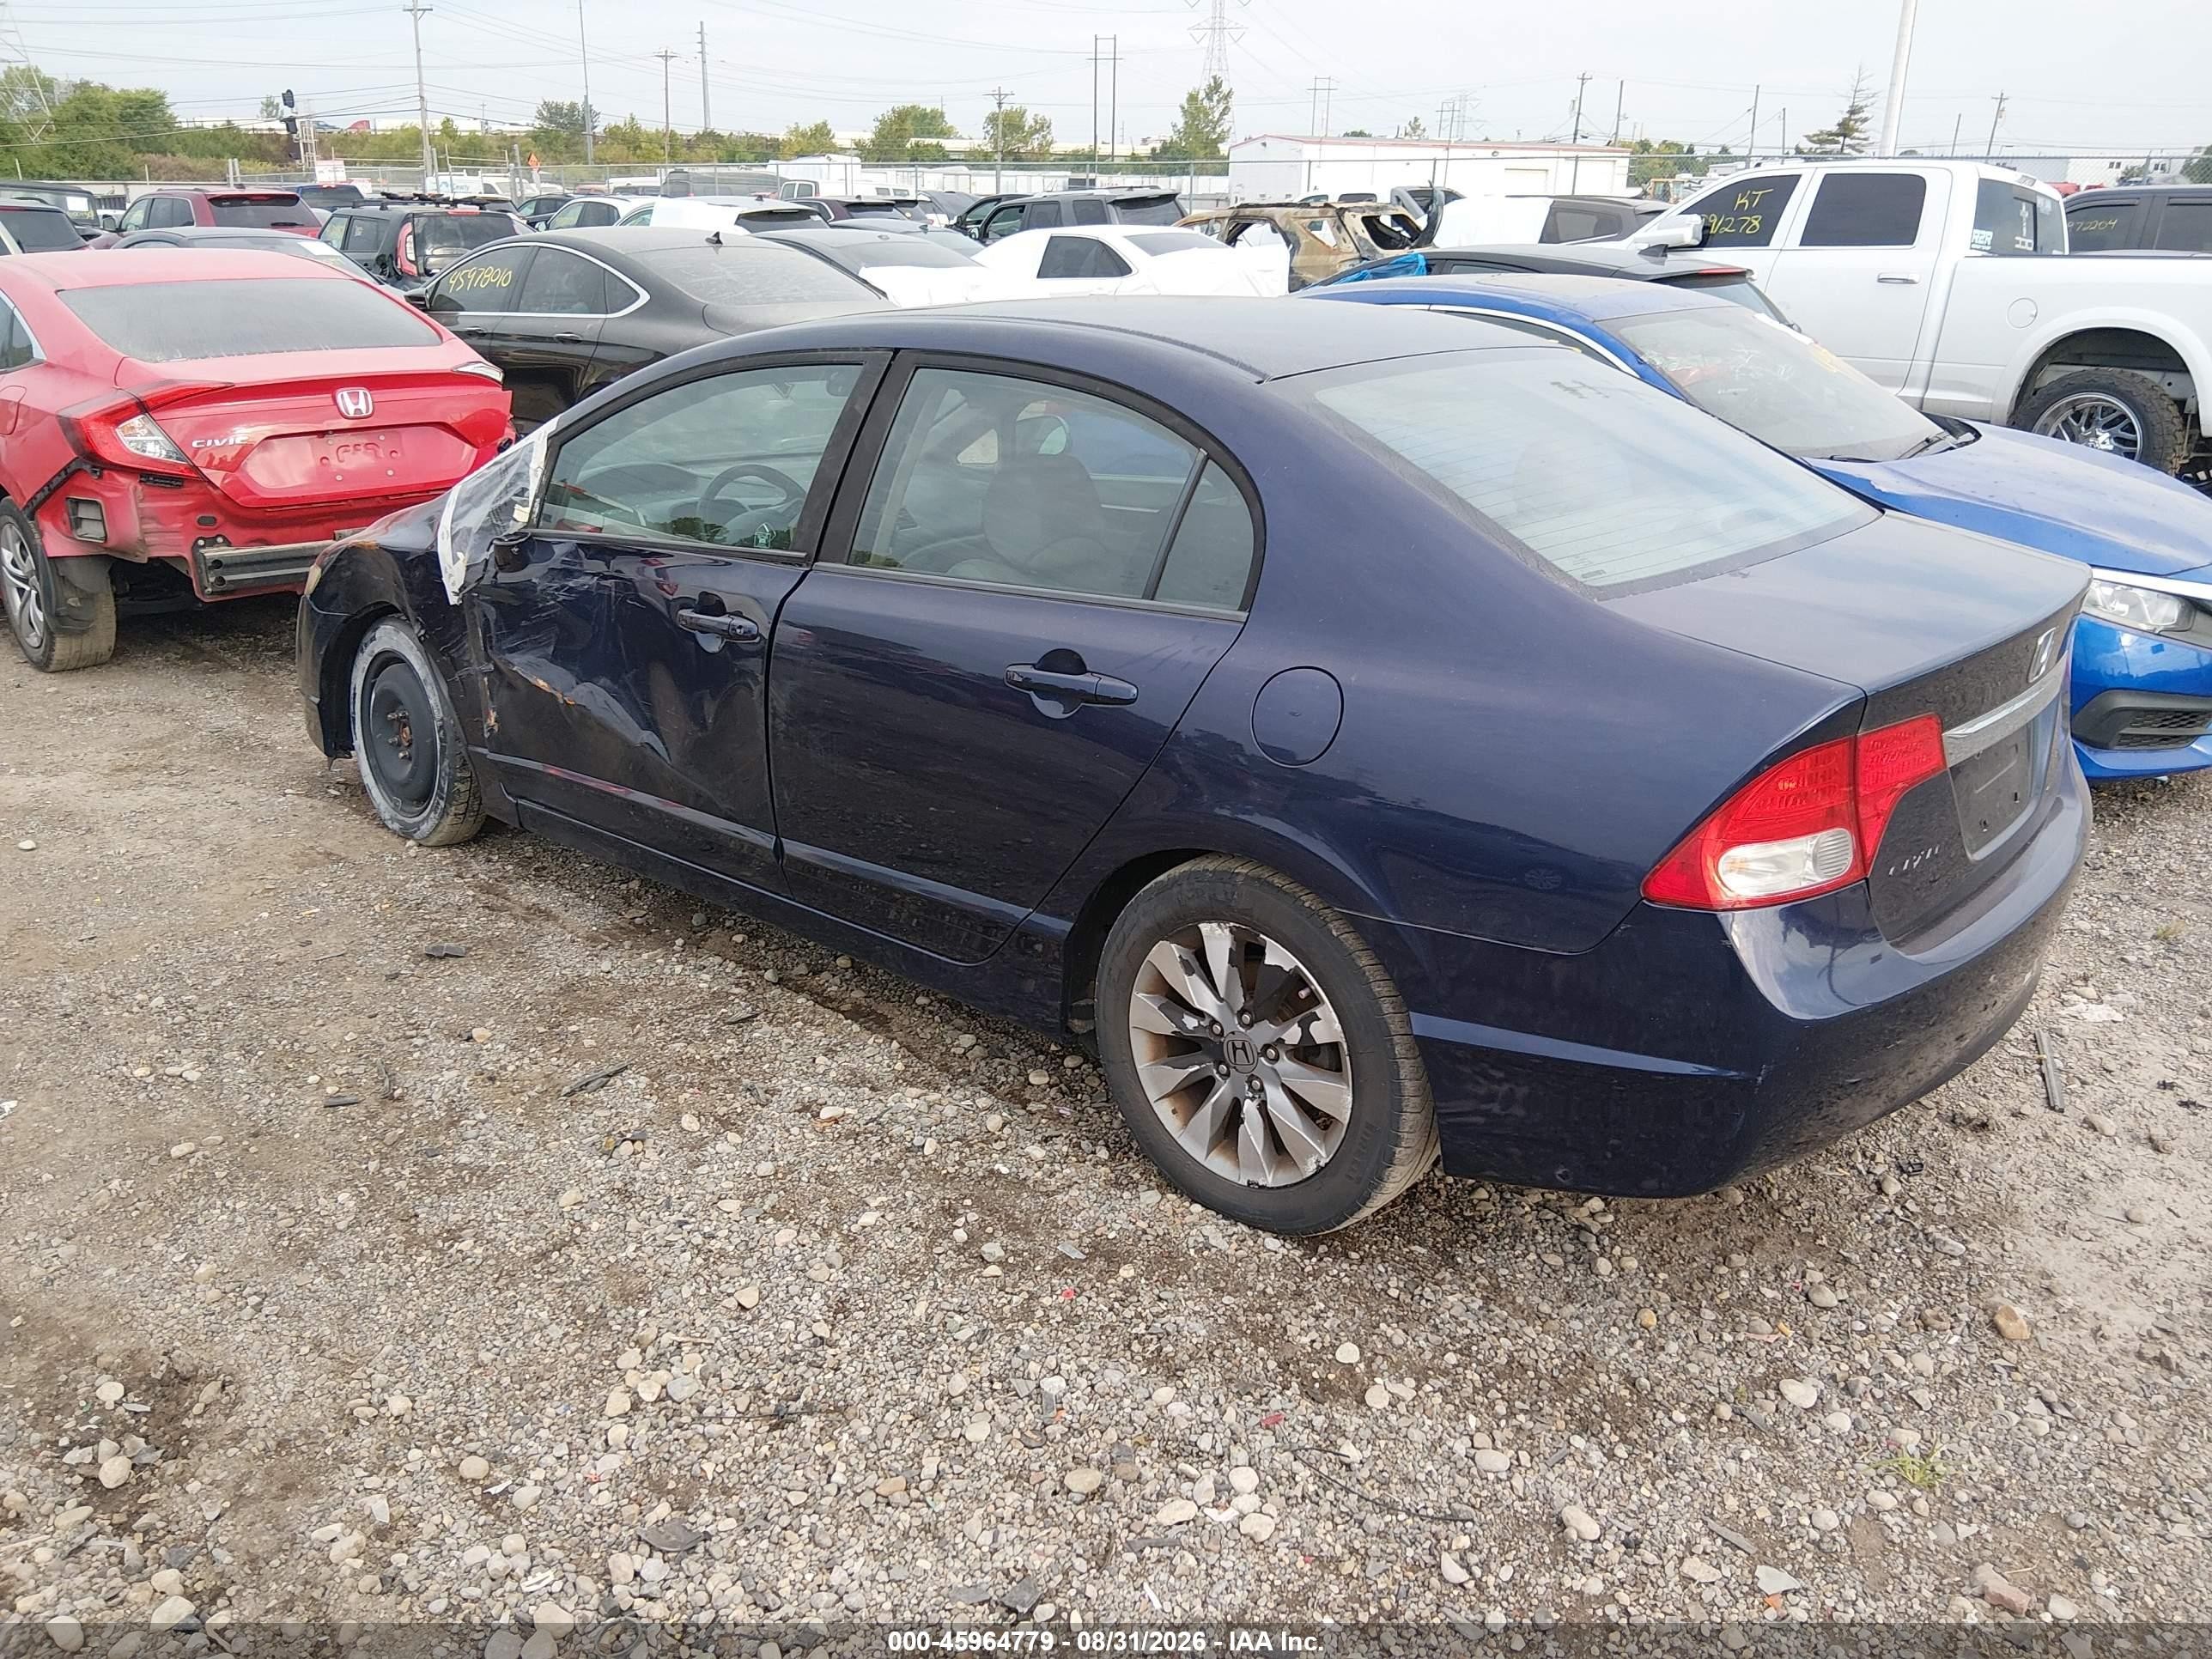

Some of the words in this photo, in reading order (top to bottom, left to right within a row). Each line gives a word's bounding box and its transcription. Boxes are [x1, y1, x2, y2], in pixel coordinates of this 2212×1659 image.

[1734, 189, 1774, 210] KT
[449, 266, 513, 293] 45978010
[192, 434, 248, 448] CIVIC
